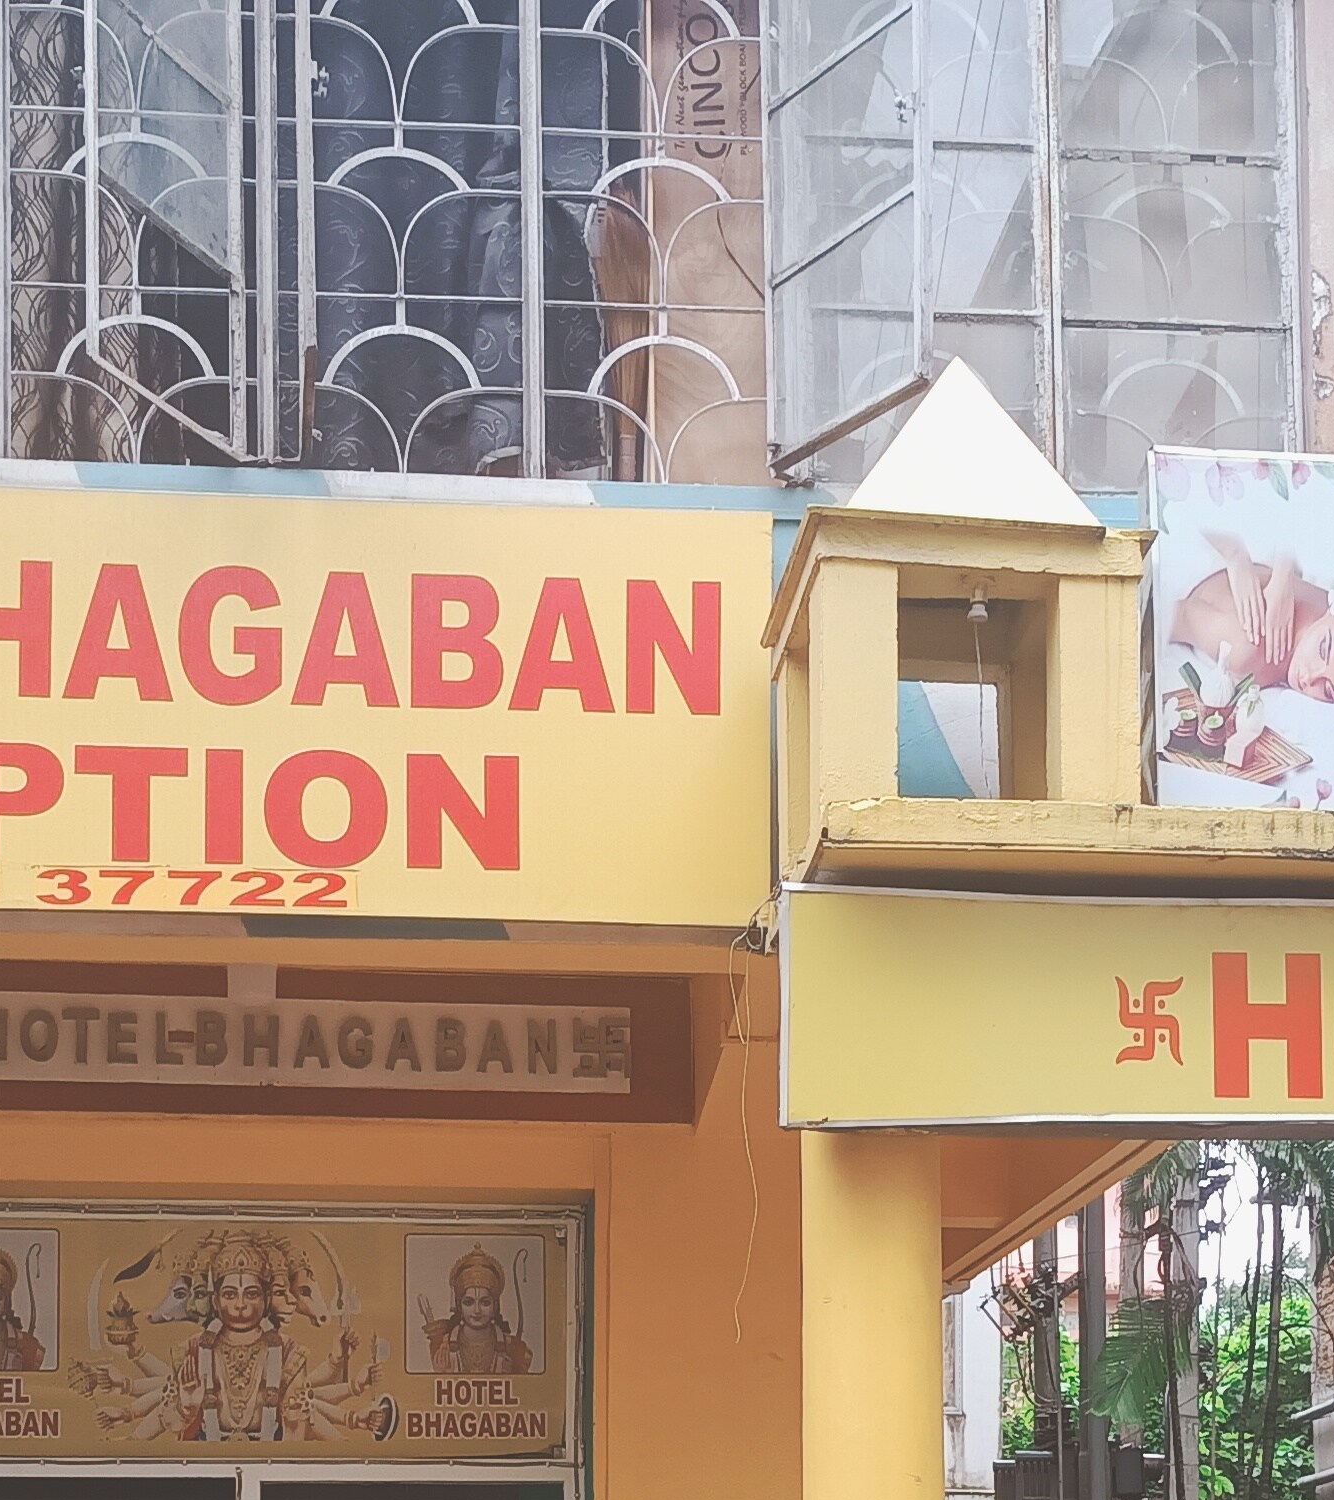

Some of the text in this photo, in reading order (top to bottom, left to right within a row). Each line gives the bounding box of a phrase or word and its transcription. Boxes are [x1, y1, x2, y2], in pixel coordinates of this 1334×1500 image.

[685, 13, 728, 159] CINCO
[34, 869, 348, 909] 37722
[433, 1378, 519, 1408] HOTEL
[405, 1410, 548, 1440] BHAGABAN
